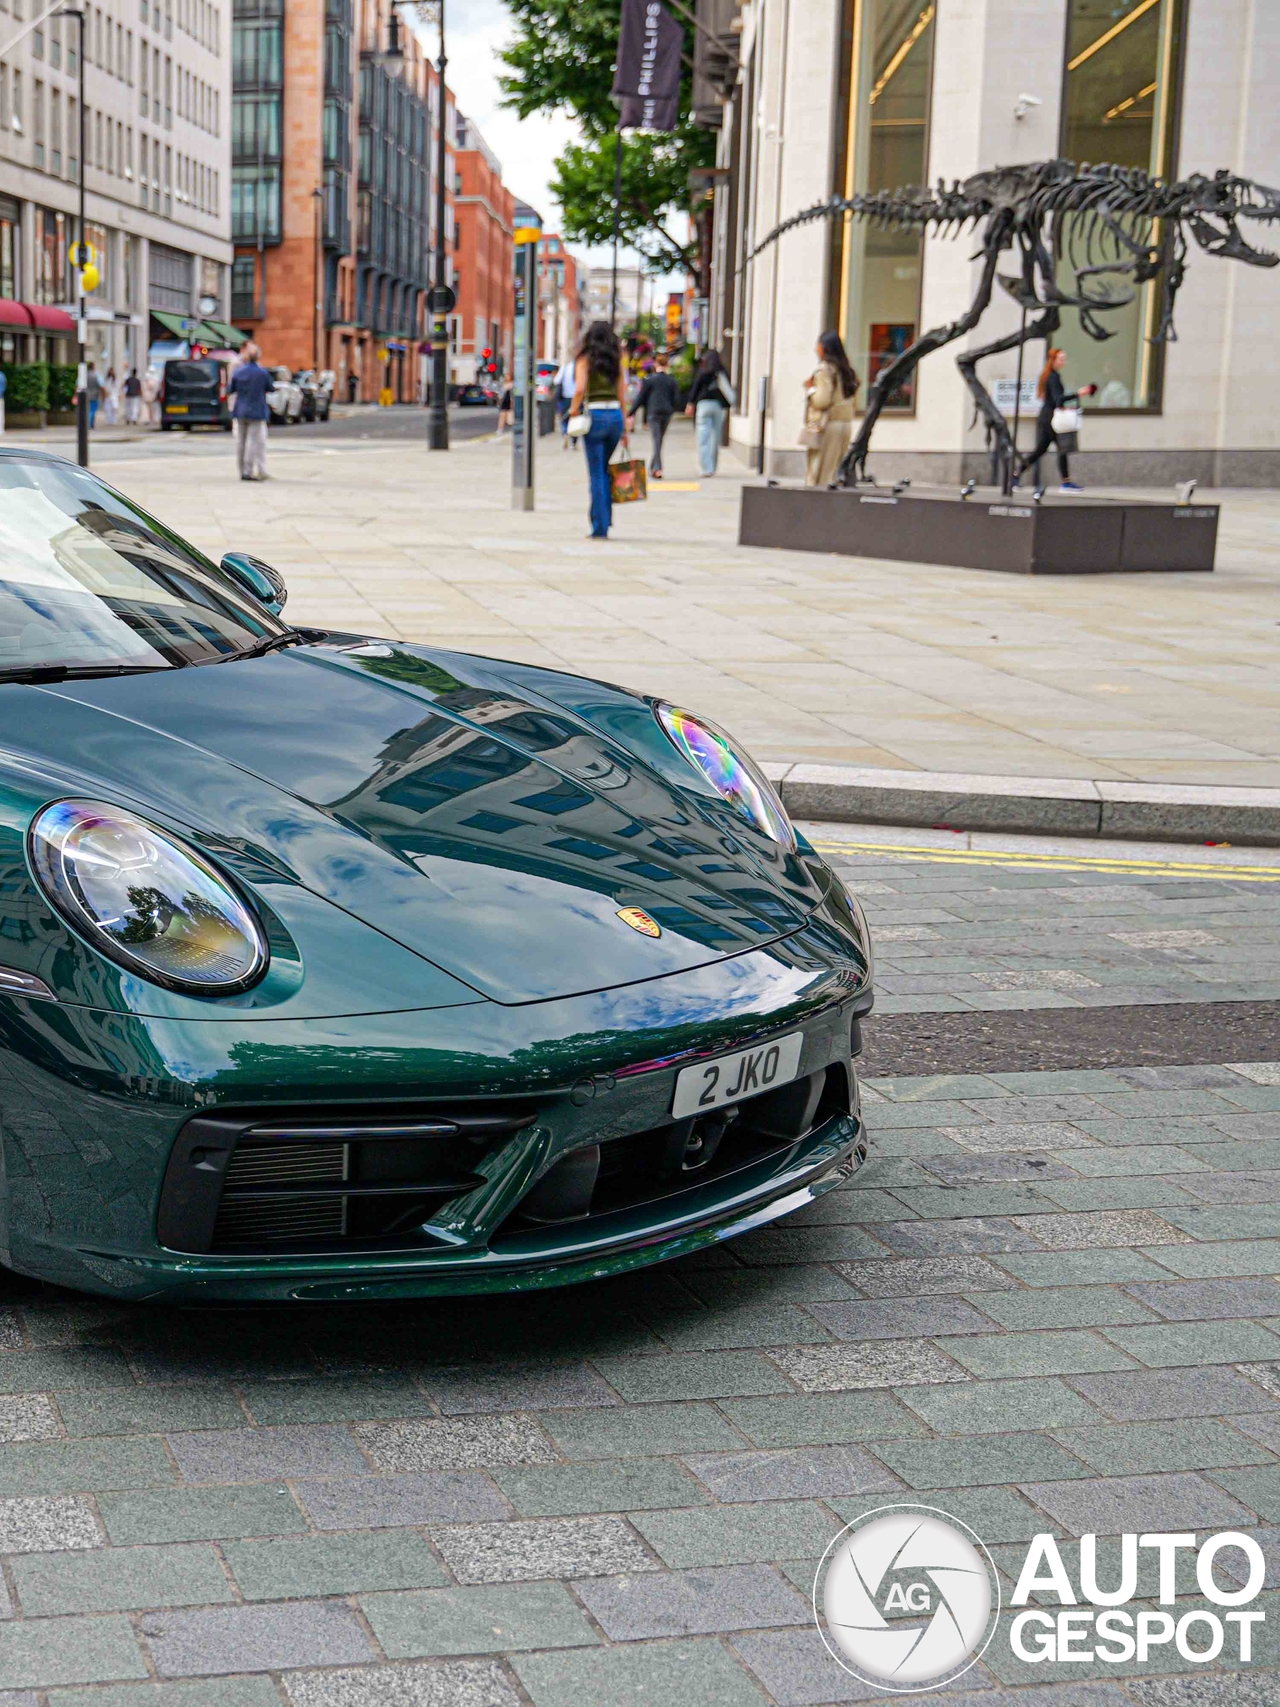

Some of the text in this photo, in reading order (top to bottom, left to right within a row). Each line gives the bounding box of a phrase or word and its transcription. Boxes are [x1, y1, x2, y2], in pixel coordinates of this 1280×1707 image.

[638, 2, 661, 96] PHILLIPS
[698, 1045, 780, 1106] 2 JKO
